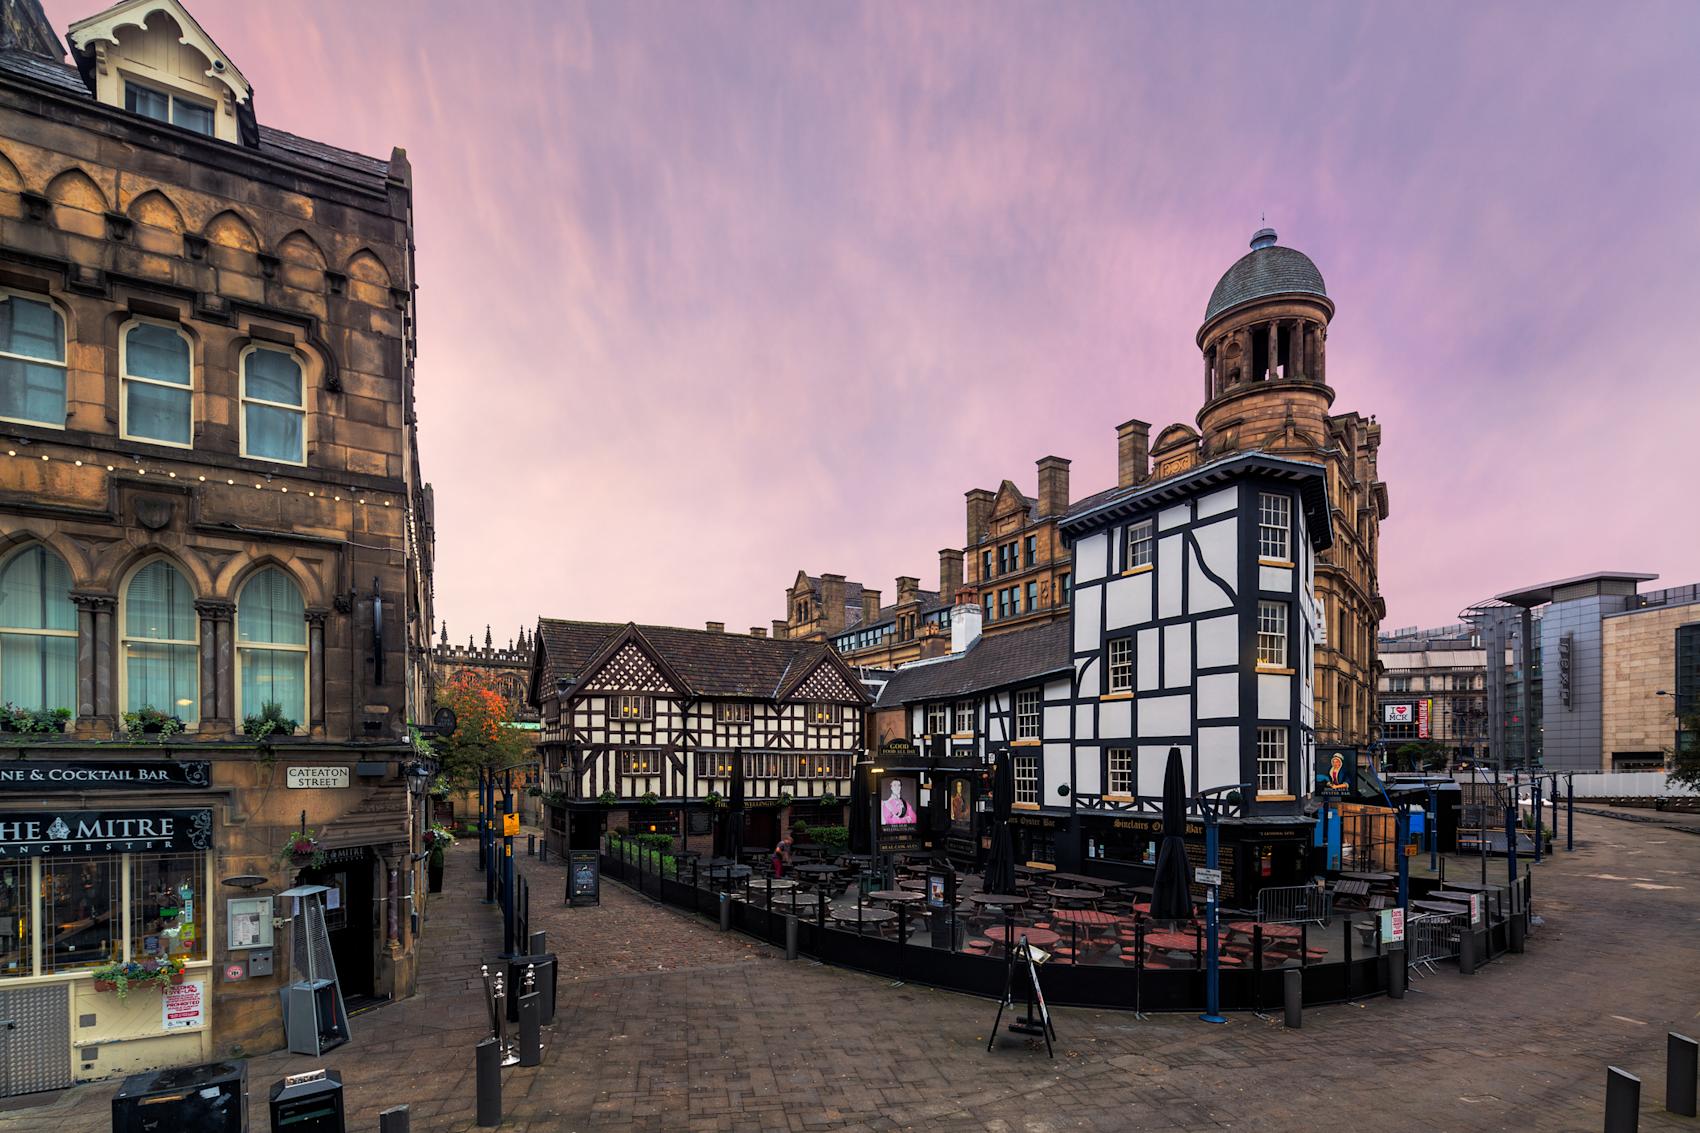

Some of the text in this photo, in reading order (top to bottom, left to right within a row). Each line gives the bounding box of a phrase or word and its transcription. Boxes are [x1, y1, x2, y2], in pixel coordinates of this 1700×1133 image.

[30, 769, 46, 781] &
[49, 769, 134, 782] COCKTAIL
[138, 769, 169, 781] BAR
[288, 768, 348, 777] CATEATON
[298, 778, 338, 786] STREET
[75, 818, 174, 839] MITRE
[1042, 817, 1056, 828] Bar
[1113, 818, 1149, 831] Sinclairs
[1185, 823, 1203, 835] Bar
